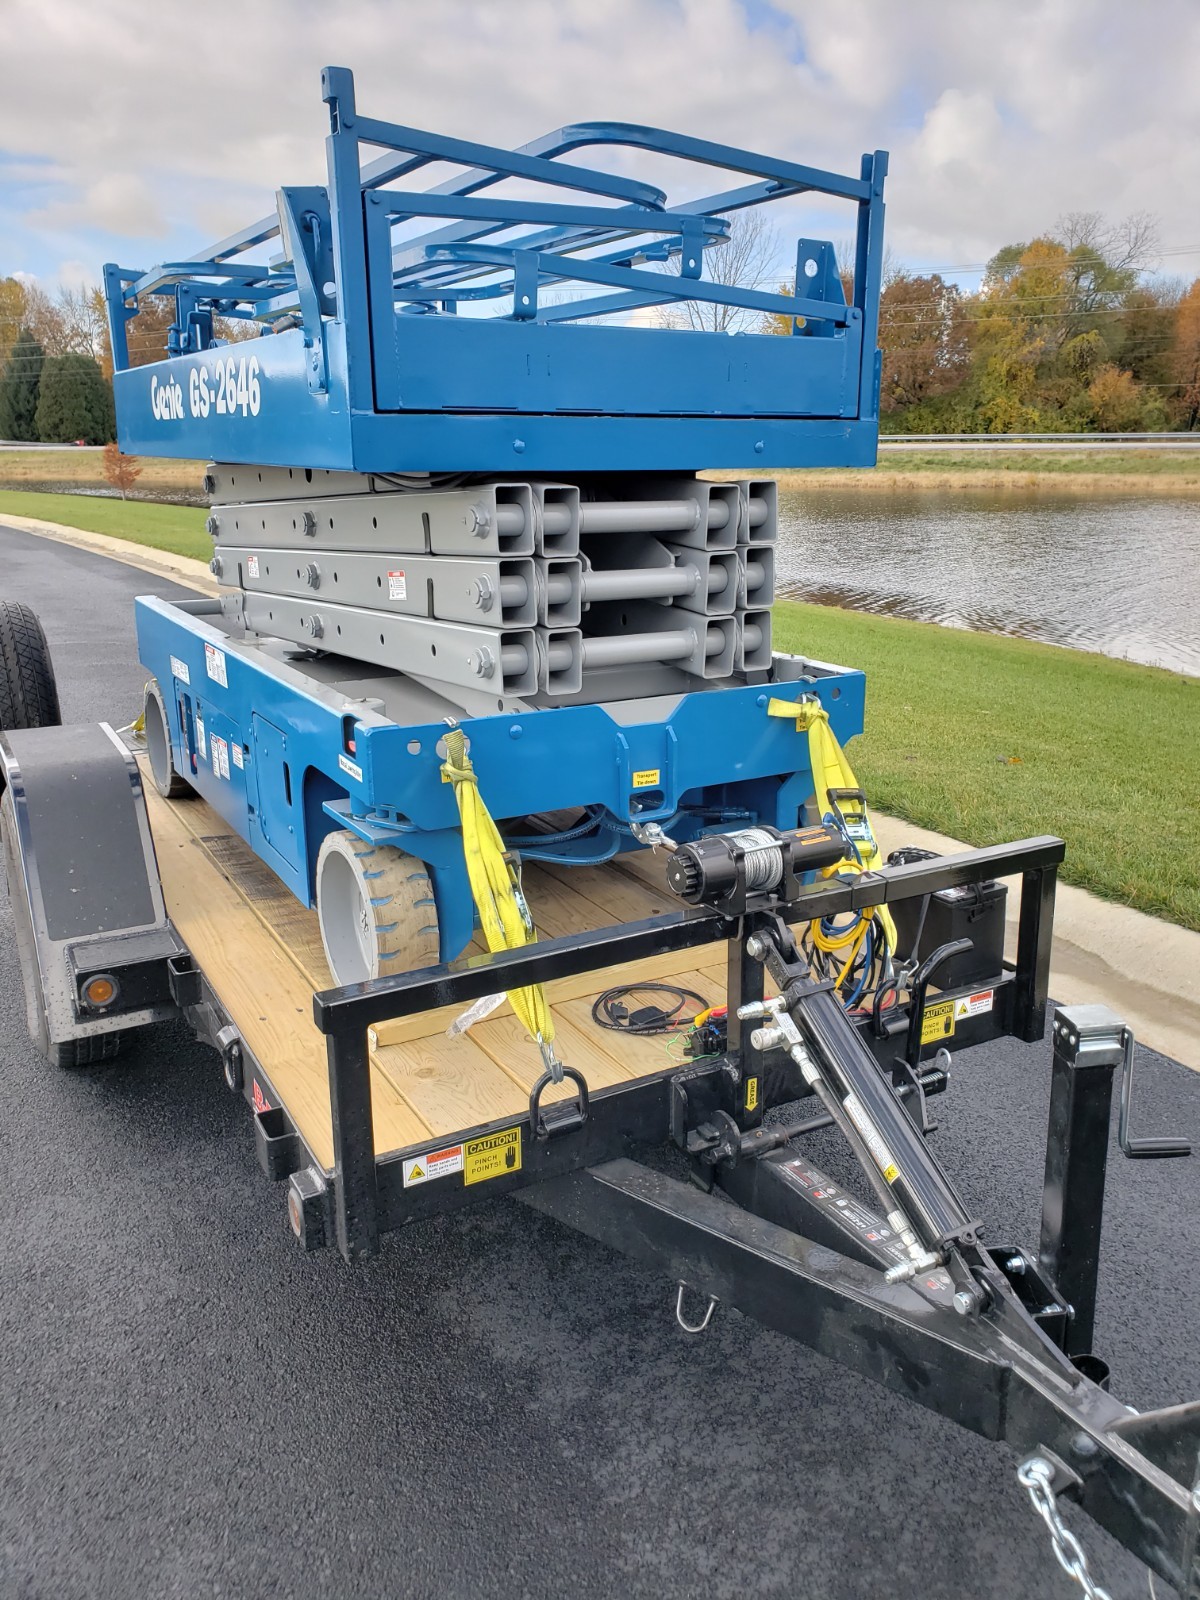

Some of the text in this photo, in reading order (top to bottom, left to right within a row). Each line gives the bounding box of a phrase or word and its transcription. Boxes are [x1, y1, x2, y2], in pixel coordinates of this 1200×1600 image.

[151, 355, 261, 420] Genie GS-2646
[470, 1133, 516, 1154] CAUTION!
[471, 1160, 502, 1174] POINTS!
[474, 1154, 498, 1166] PINCH
